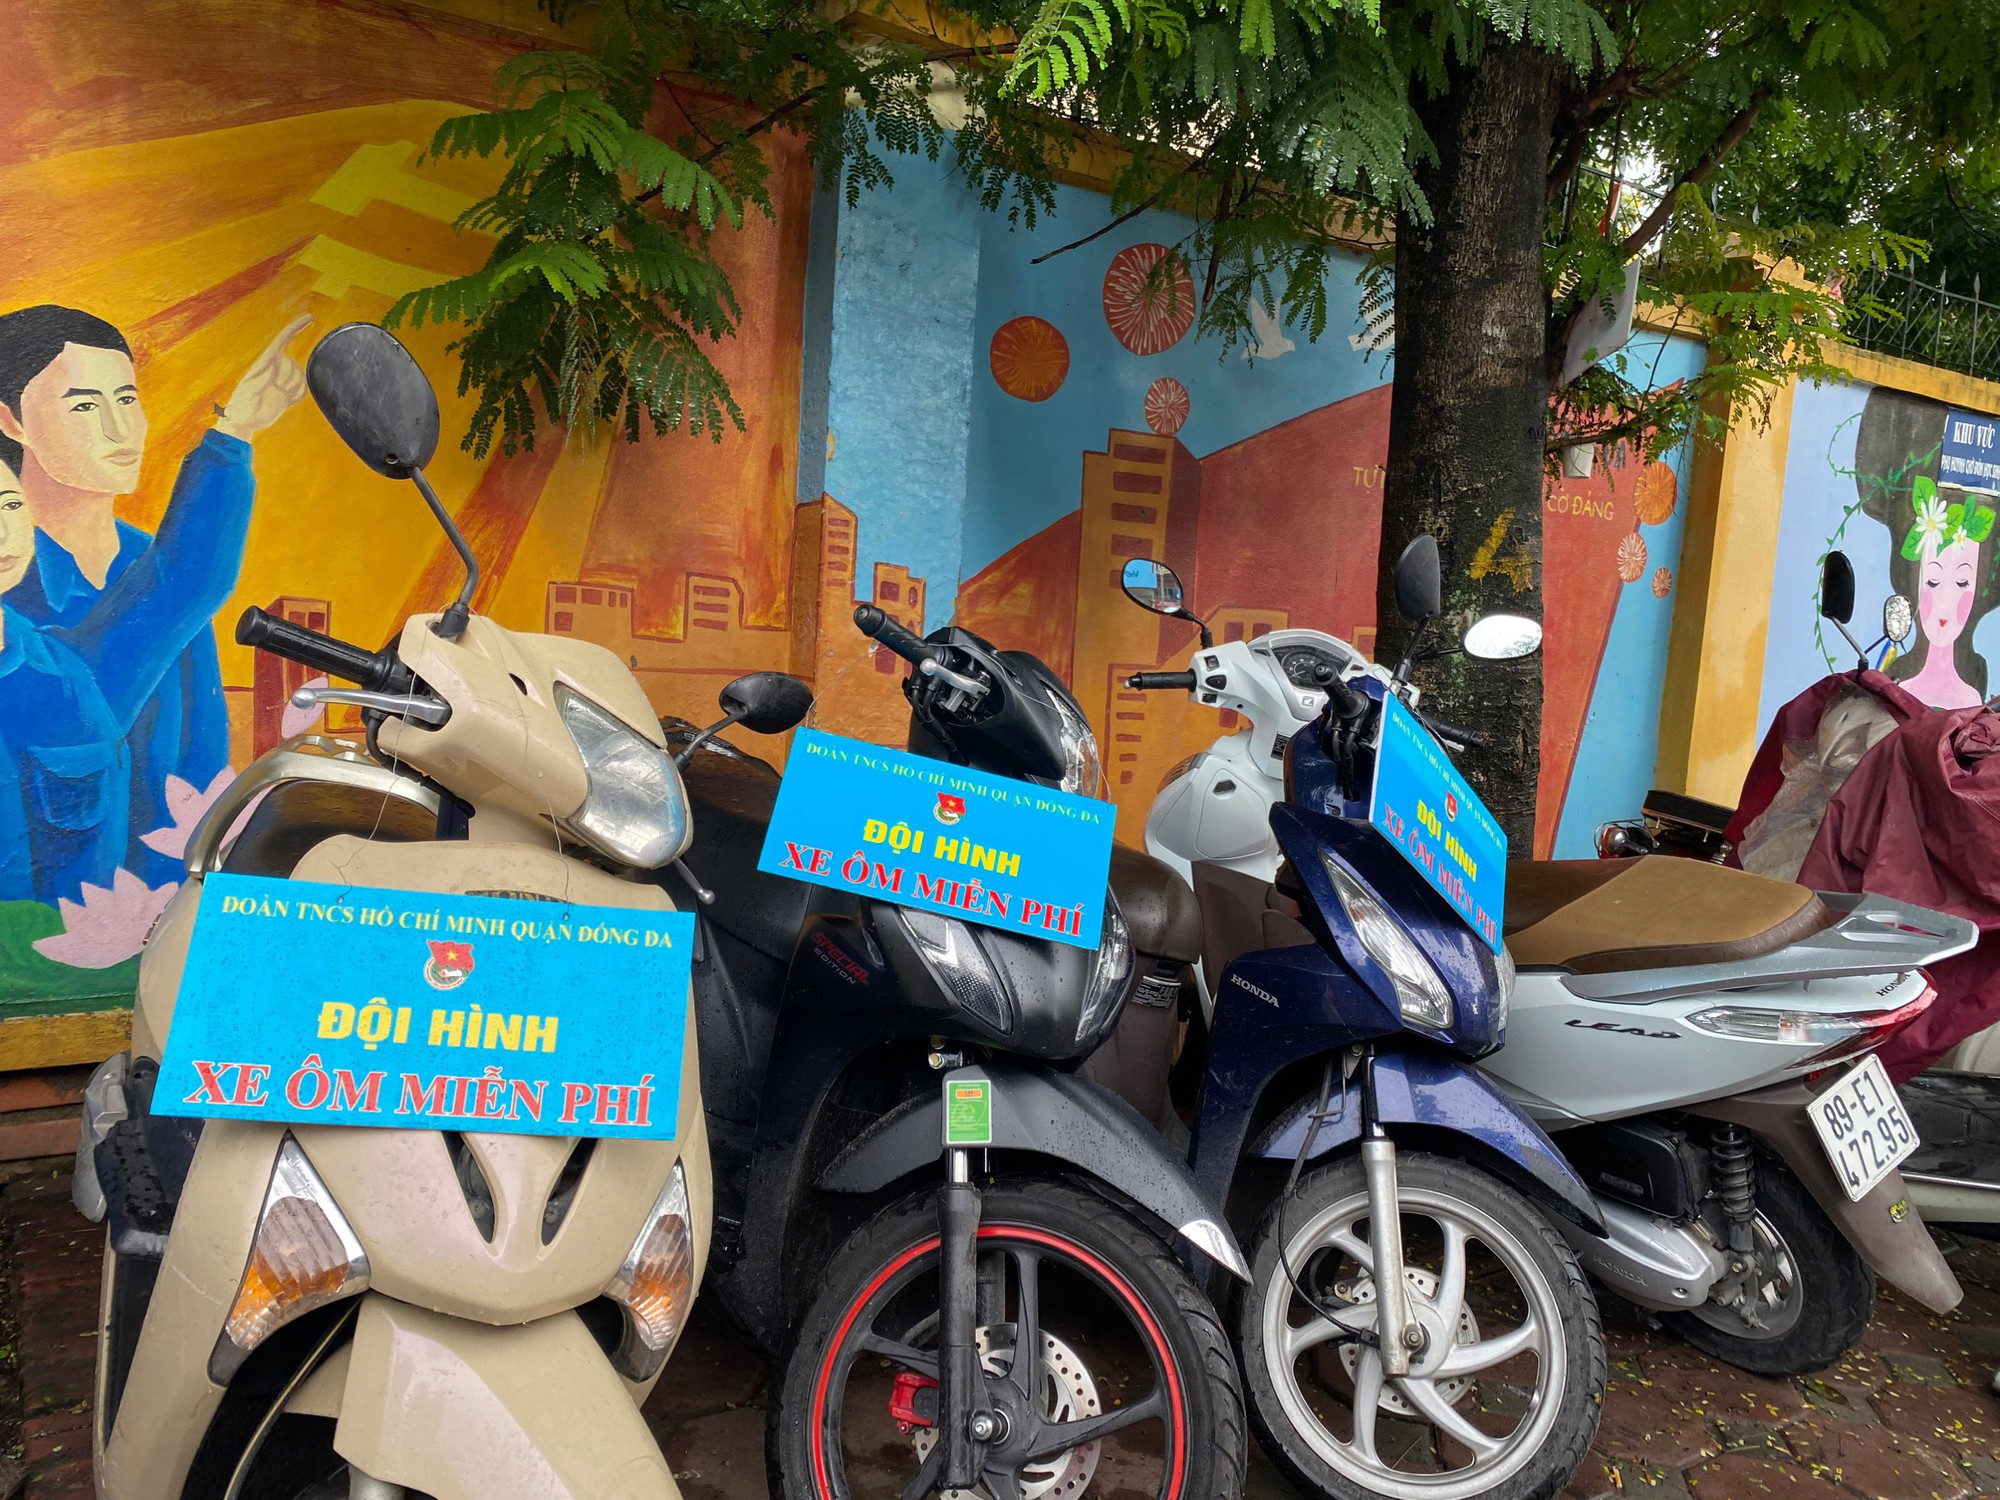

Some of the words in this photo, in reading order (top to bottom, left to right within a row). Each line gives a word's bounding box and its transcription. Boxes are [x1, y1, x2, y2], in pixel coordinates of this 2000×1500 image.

[1953, 421, 1976, 445] KHU
[1977, 424, 1996, 454] VỰC
[1547, 488, 1570, 513] CỜ
[1571, 490, 1615, 520] ĐẢNG
[853, 754, 889, 772] TNCS
[918, 770, 945, 786] CHÍ
[950, 778, 987, 796] MINH
[863, 818, 924, 855] ĐỘI
[934, 835, 1021, 877] HÌNH
[1417, 799, 1442, 842] ĐỘI
[1445, 831, 1477, 883] HÌNH
[778, 841, 833, 877] XE
[841, 850, 905, 894] ÔM
[911, 873, 1013, 920] MIỄN
[1018, 896, 1085, 937] PHÍ
[1382, 802, 1405, 844] XE
[1409, 828, 1435, 874] ÔM
[1476, 905, 1498, 945] PHÍ
[221, 894, 290, 918] ĐOÀN
[295, 902, 355, 924] TNCS
[360, 905, 394, 927] HỒ
[399, 909, 441, 931] CHÍ
[445, 915, 505, 936] MINH
[510, 920, 573, 943] QUẬN
[578, 922, 639, 946] ĐỐNG
[644, 930, 673, 948] ĐA
[812, 931, 870, 985] SPECIAL
[814, 947, 856, 984] EDITION
[1876, 973, 1911, 997] HONA
[1230, 973, 1280, 1009] HONDA
[317, 997, 412, 1051] ĐỘI
[428, 1003, 559, 1053] HÌNH
[1564, 1019, 1682, 1039] LEAD
[182, 1060, 271, 1107] XE
[286, 1054, 387, 1113] ÔM
[393, 1065, 549, 1121] MIỄN
[558, 1074, 655, 1126] PHÍ
[1822, 1070, 1884, 1141] 89-E1
[1838, 1106, 1910, 1188] 472.95
